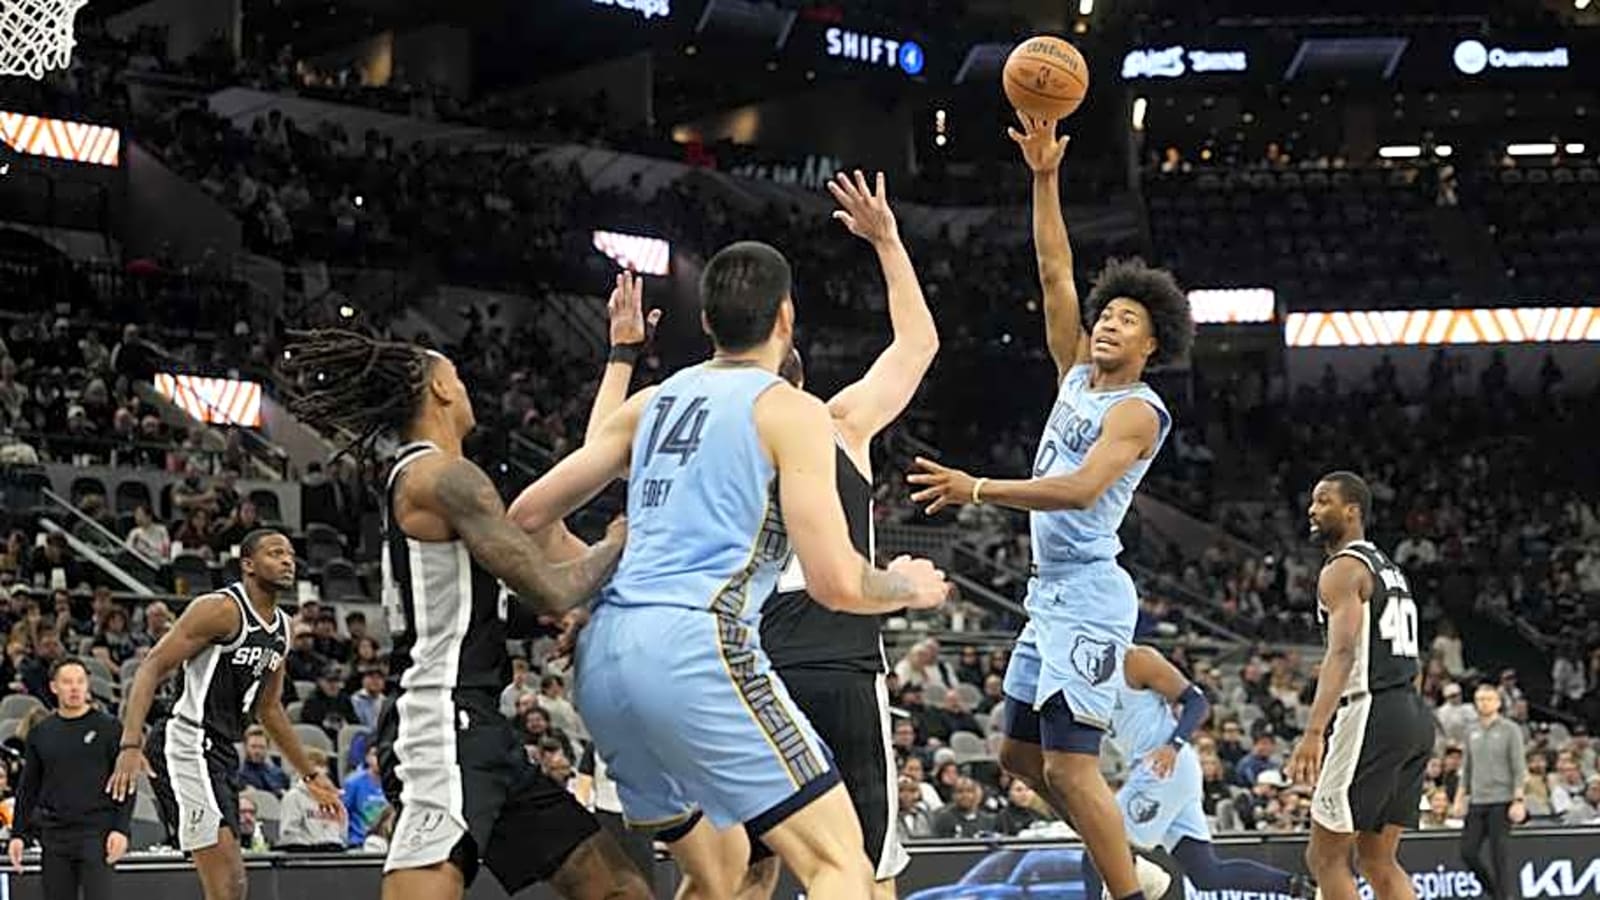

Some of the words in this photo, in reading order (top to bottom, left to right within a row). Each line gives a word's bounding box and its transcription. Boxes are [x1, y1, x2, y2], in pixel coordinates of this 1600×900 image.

[643, 396, 709, 468] 14
[641, 478, 675, 509] EDEY
[1379, 596, 1419, 658] 40
[1411, 864, 1483, 900] spires
